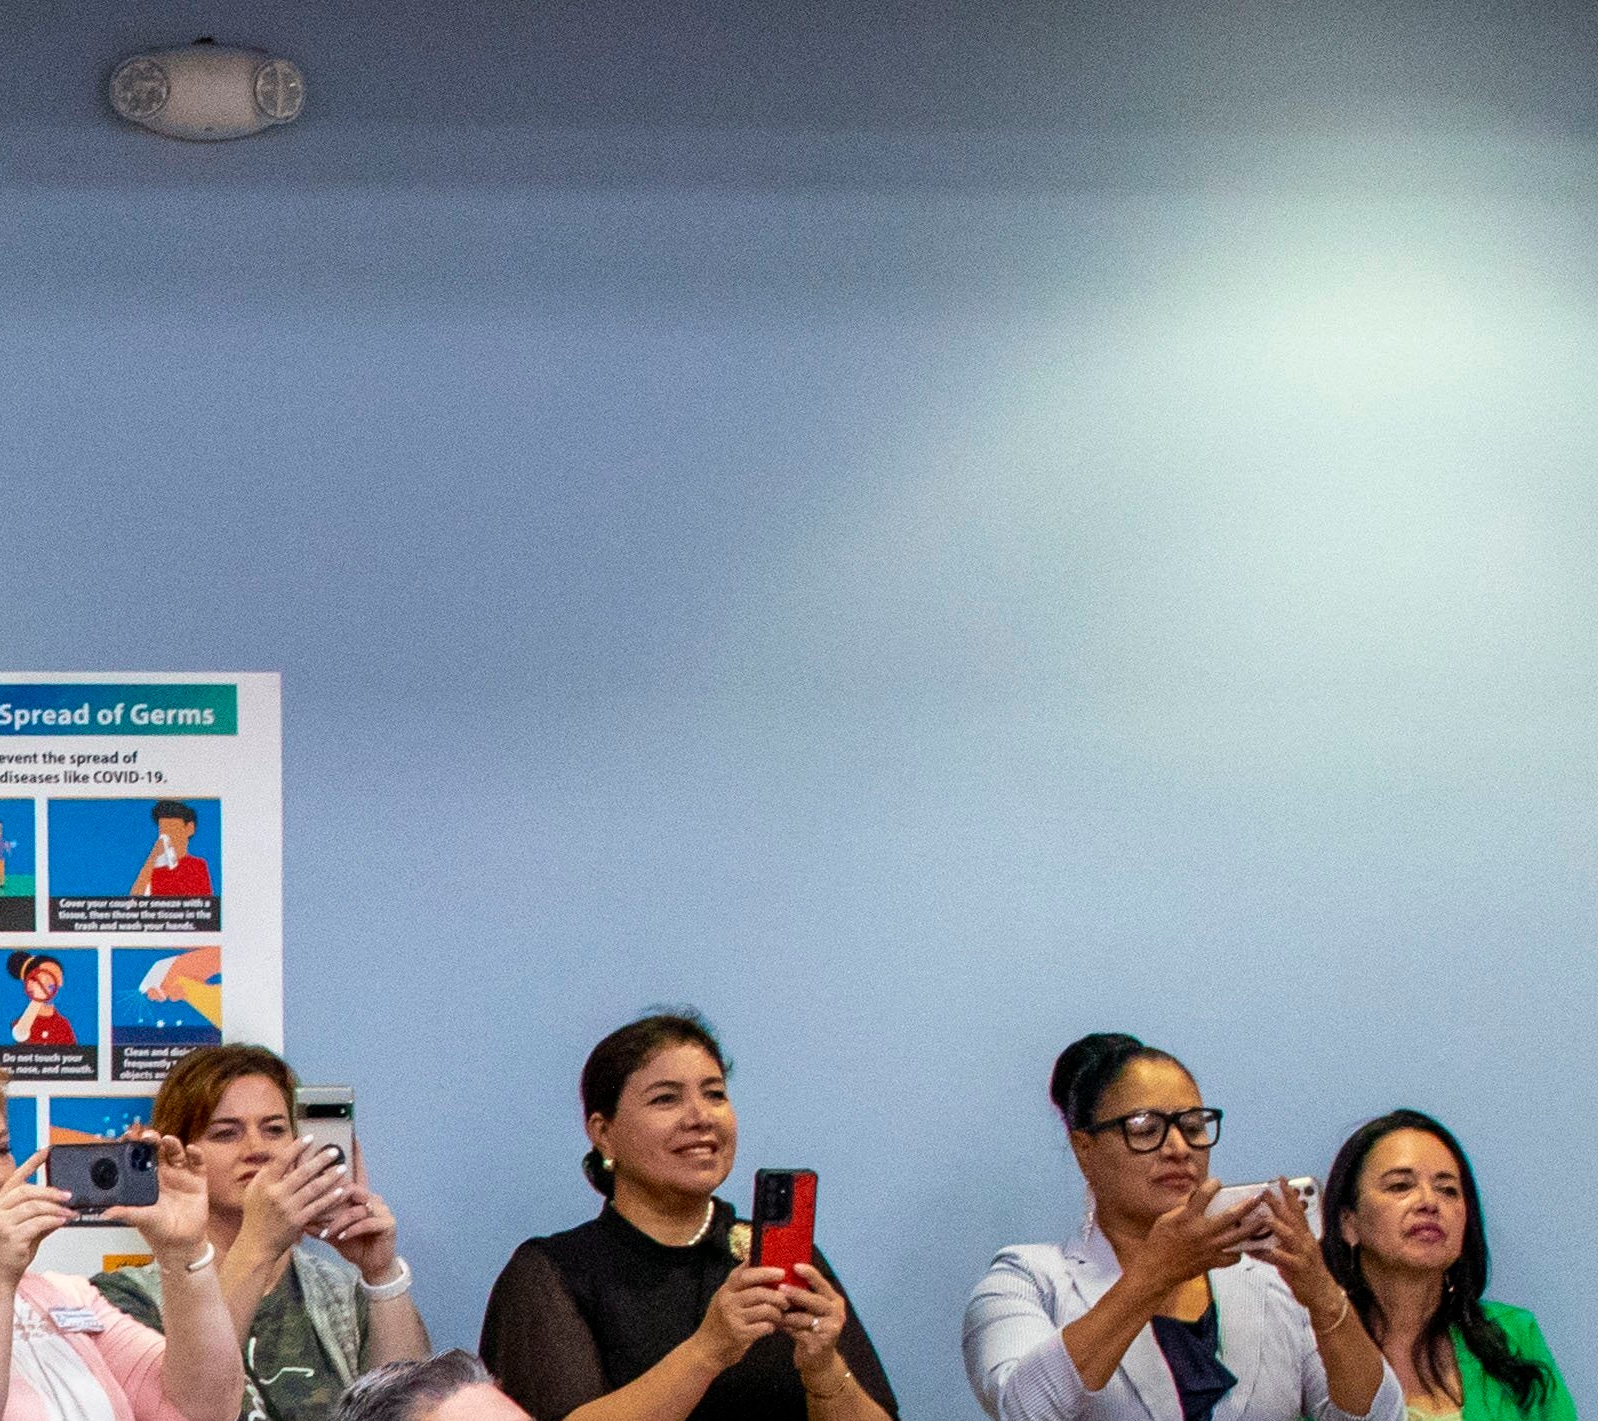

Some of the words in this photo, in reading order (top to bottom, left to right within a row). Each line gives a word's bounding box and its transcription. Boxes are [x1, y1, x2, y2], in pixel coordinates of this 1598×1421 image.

[97, 703, 123, 725] of
[130, 704, 215, 725] Germs
[42, 751, 66, 764] the
[70, 751, 119, 767] spread
[123, 750, 138, 764] of
[0, 771, 60, 784] diseases
[64, 771, 90, 784] like
[93, 771, 167, 784] COVID-19.
[59, 899, 86, 908] Cover
[87, 901, 107, 909] your
[109, 899, 137, 909] cough
[183, 899, 204, 908] with
[89, 911, 110, 919] then
[112, 911, 139, 919] throw
[141, 911, 156, 919] the
[157, 911, 184, 919] tissue
[196, 911, 211, 919] the
[74, 922, 98, 930] trash
[99, 922, 117, 930] and
[119, 922, 142, 930] wash
[144, 923, 165, 932] your
[124, 1047, 149, 1057] Clean
[151, 1047, 169, 1057] and
[3, 1053, 16, 1062] Do
[18, 1054, 32, 1062] not
[34, 1053, 60, 1063] touch
[62, 1054, 83, 1065] your
[124, 1059, 171, 1070] frequently
[16, 1067, 40, 1075] nose,
[42, 1065, 59, 1073] and
[61, 1065, 94, 1074] mouth.
[120, 1071, 153, 1080] objects
